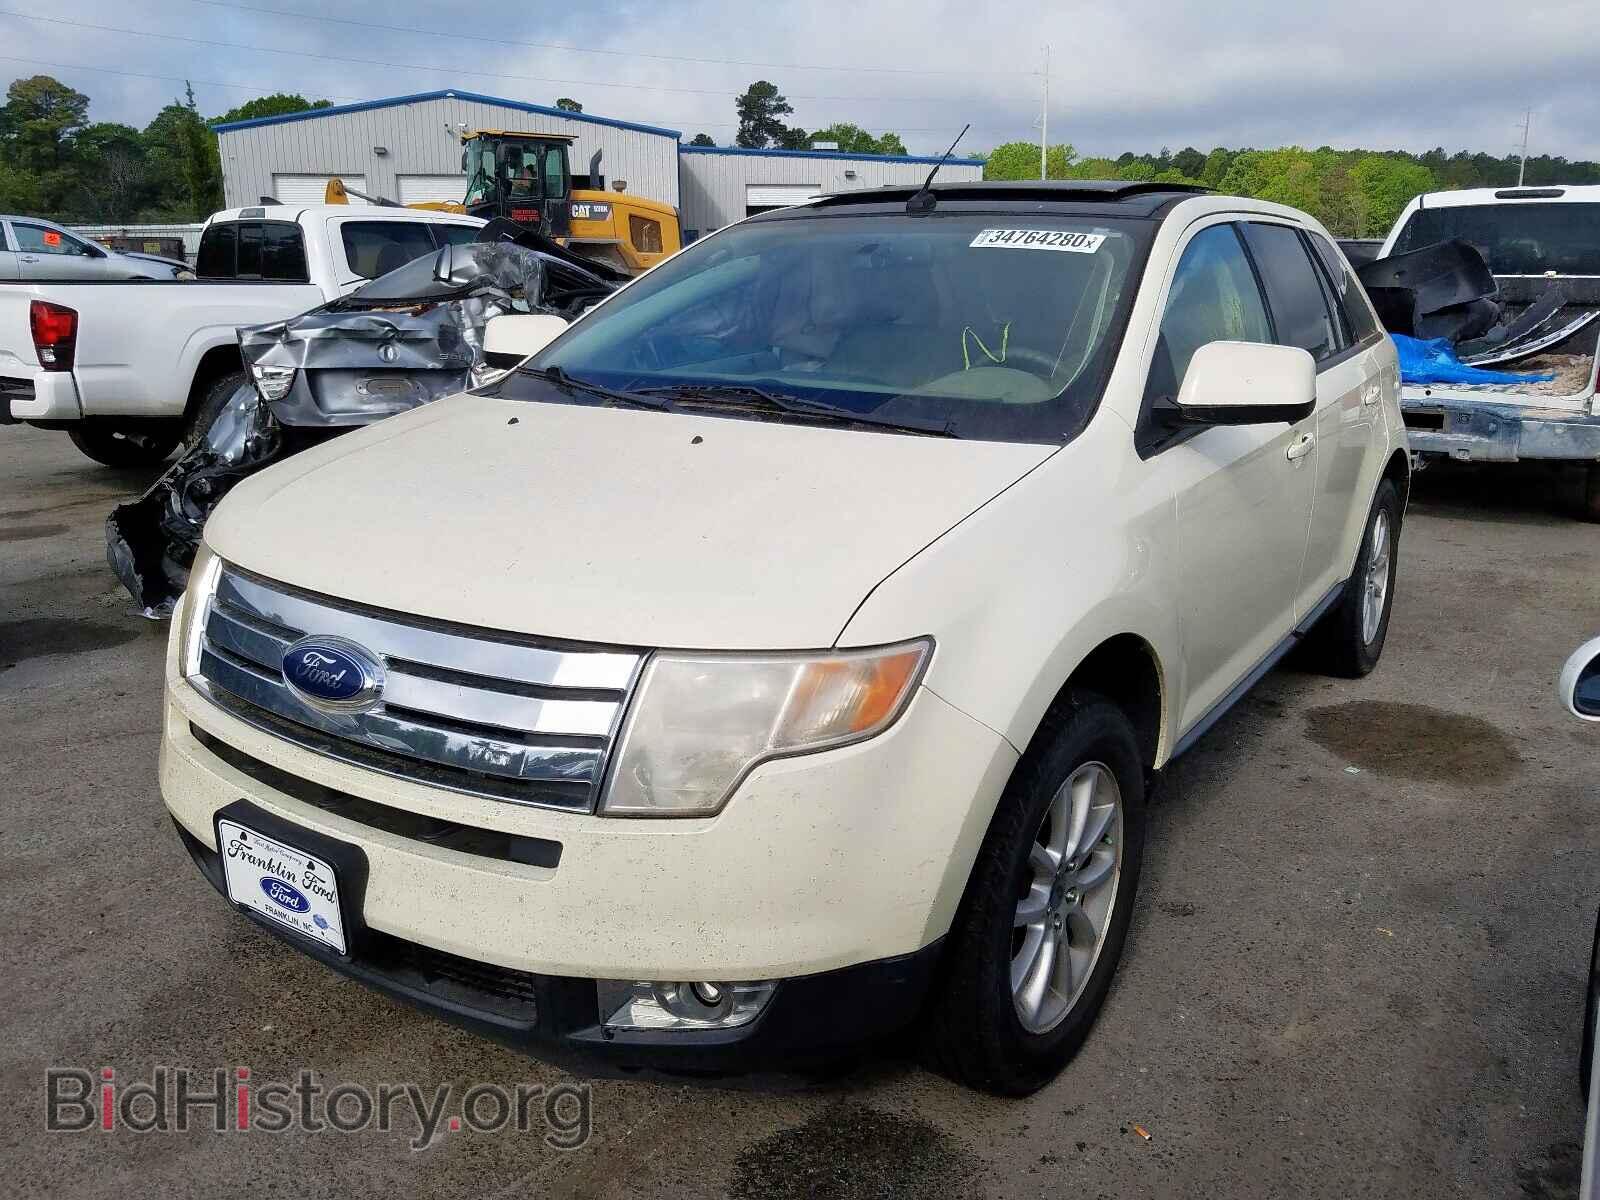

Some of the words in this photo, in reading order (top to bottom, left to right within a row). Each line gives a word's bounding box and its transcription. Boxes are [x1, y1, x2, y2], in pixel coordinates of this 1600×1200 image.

[571, 204, 590, 218] CAT
[988, 229, 1088, 248] 34764280
[295, 651, 347, 689] Ford
[227, 839, 298, 883] Franklin
[302, 871, 336, 904] Ford
[270, 882, 300, 909] Ford
[302, 921, 314, 933] NC
